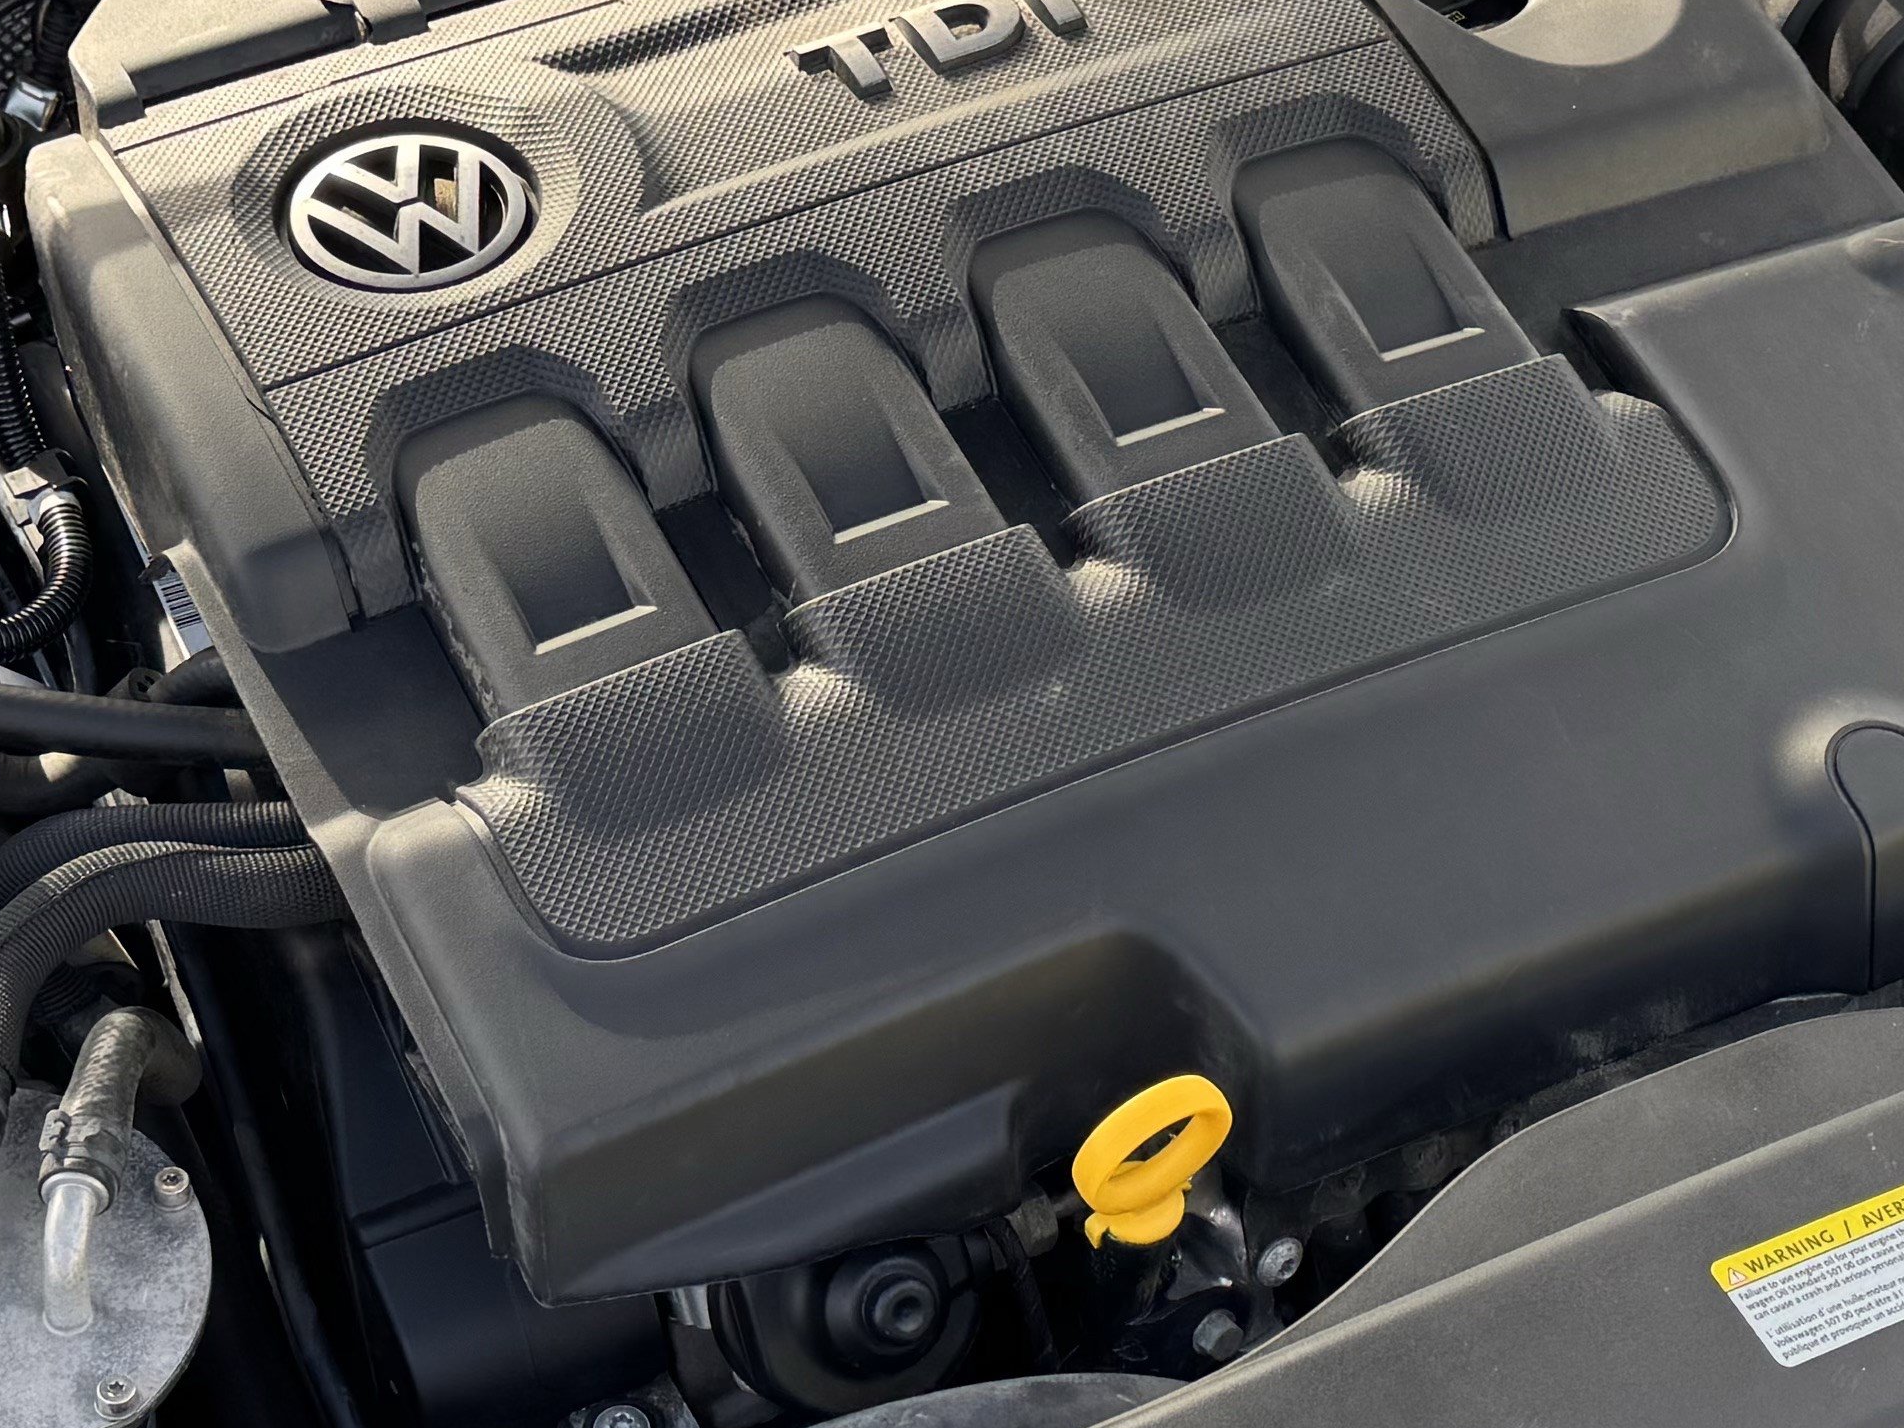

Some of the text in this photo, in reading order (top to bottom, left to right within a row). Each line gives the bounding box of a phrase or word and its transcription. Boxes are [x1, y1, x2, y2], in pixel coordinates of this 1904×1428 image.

[1737, 1282, 1767, 1301] Failure
[1765, 1277, 1779, 1289] to
[1778, 1273, 1794, 1284] use
[1792, 1260, 1824, 1281] engine
[1821, 1255, 1834, 1266] oil
[1834, 1249, 1848, 1261] for
[1847, 1243, 1869, 1259] your
[1866, 1230, 1898, 1251] engine
[1743, 1227, 1836, 1275] WARNING
[1838, 1219, 1855, 1237] /
[1745, 1294, 1777, 1313] wagen
[1774, 1287, 1789, 1299] Oil
[1787, 1271, 1827, 1293] Standard
[1826, 1264, 1843, 1278] 507
[1843, 1259, 1856, 1271] 00
[1855, 1254, 1871, 1266] can
[1871, 1245, 1895, 1260] cause
[1753, 1309, 1770, 1321] can
[1769, 1299, 1794, 1314] cause
[1793, 1296, 1802, 1304] a
[1800, 1285, 1824, 1301] crash
[1823, 1278, 1841, 1292] and
[1840, 1266, 1871, 1285] serious
[1773, 1320, 1826, 1352] Volkswagen
[1823, 1314, 1841, 1328] 507
[1840, 1308, 1853, 1321] 00
[1852, 1300, 1875, 1318] peut
[1781, 1336, 1821, 1361] publique
[1817, 1332, 1831, 1344] et
[1872, 1310, 1885, 1321] un
